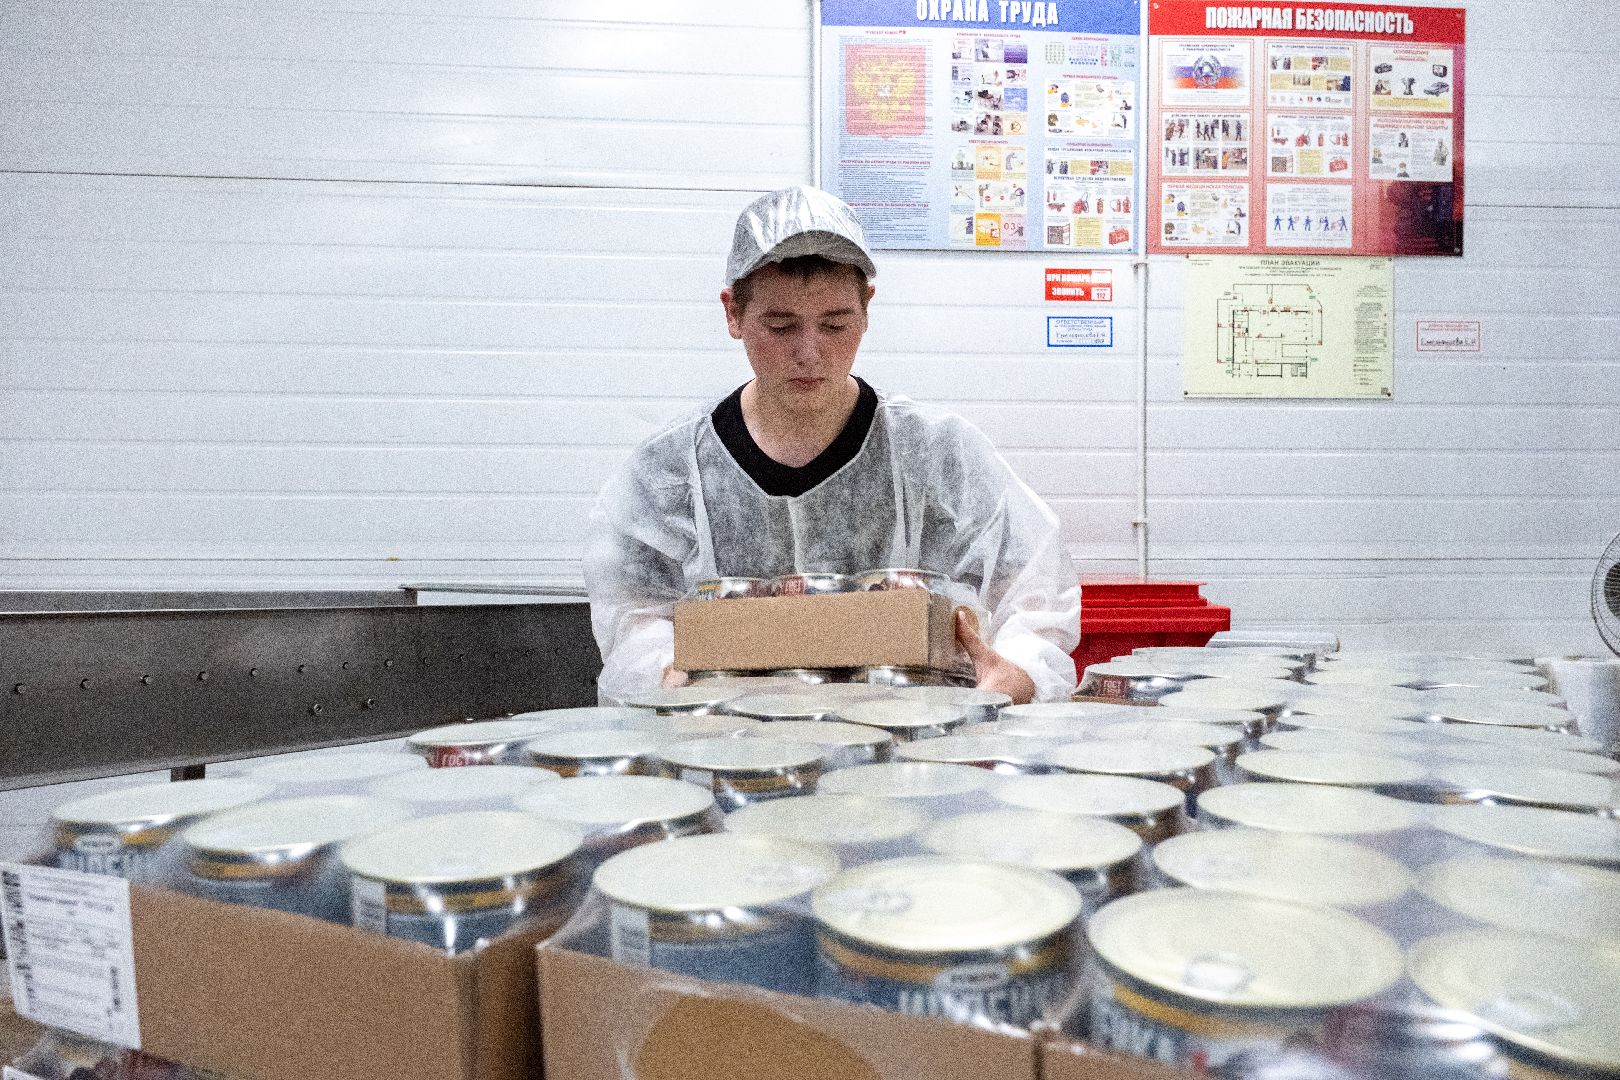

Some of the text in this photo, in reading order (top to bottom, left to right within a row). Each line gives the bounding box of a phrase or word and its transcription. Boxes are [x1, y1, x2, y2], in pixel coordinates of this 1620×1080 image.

[916, 0, 1059, 27] ОХРАНА ТРУДА
[1205, 7, 1415, 34] ПОЖАРНАЯ БЕЗОПАСНОСТЬ
